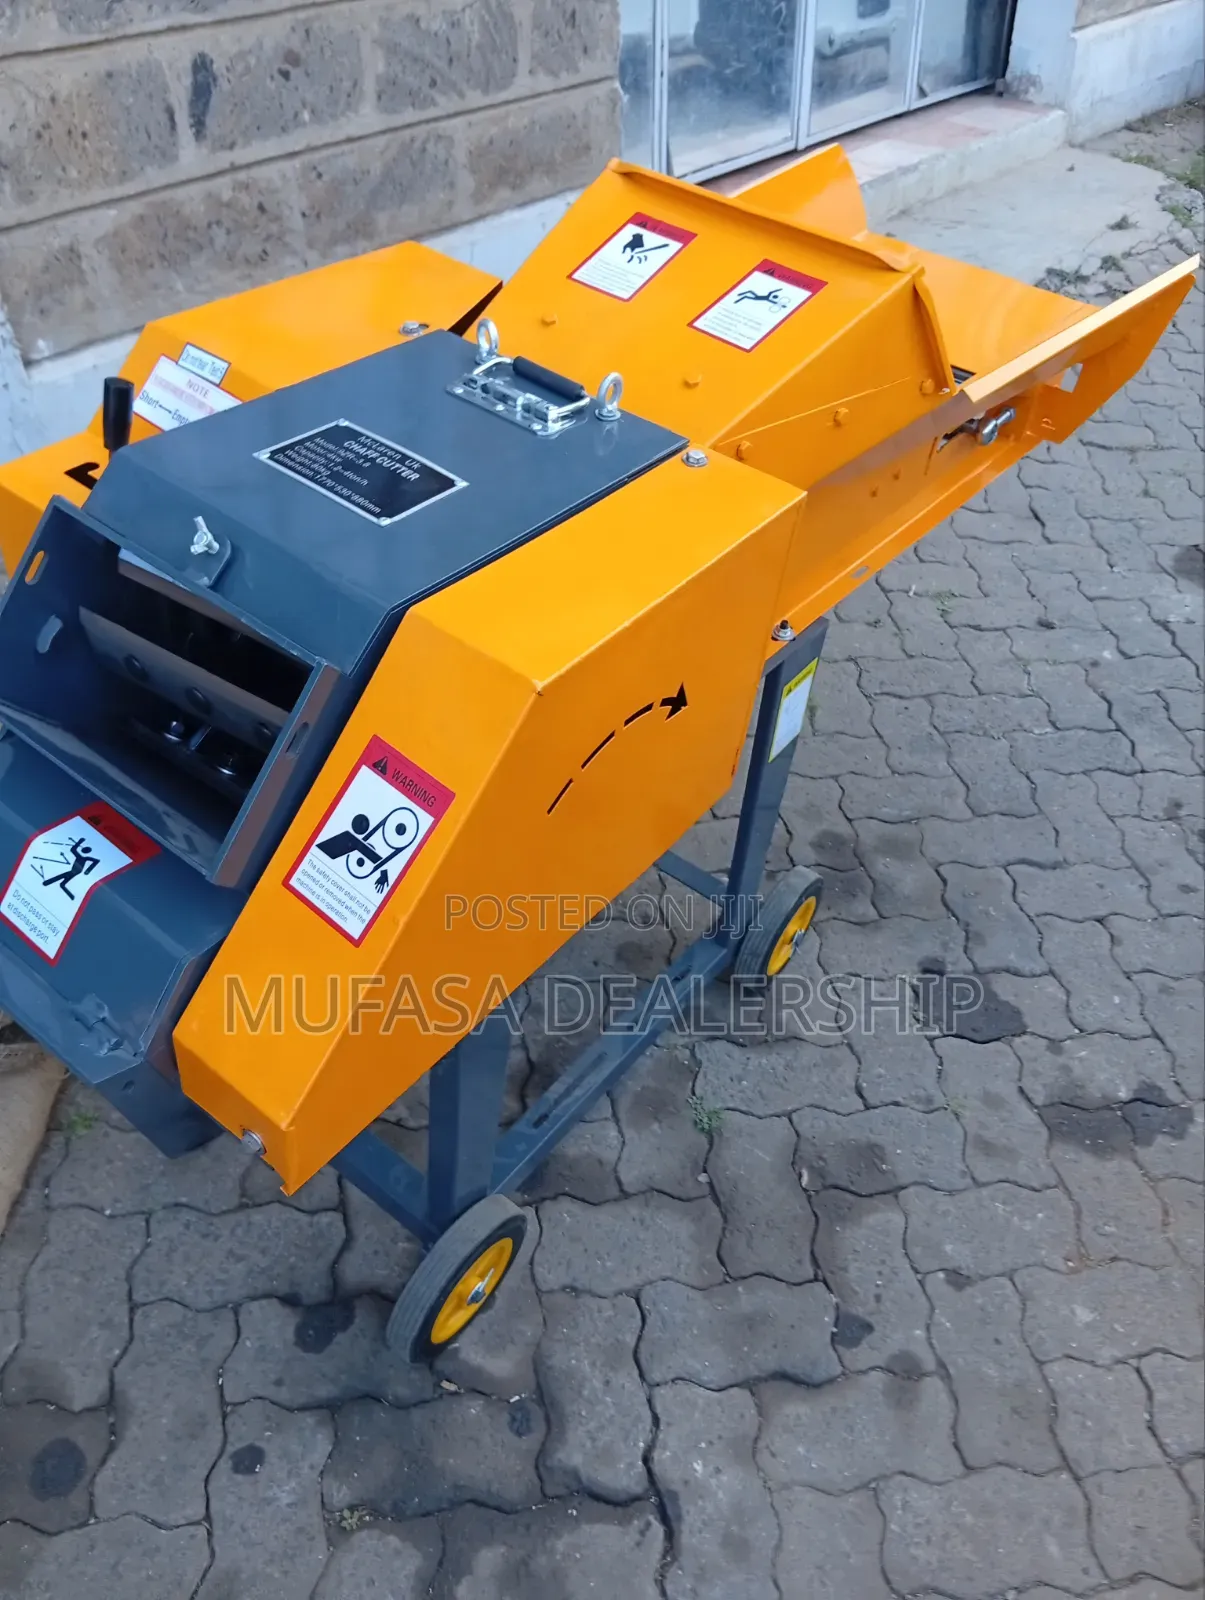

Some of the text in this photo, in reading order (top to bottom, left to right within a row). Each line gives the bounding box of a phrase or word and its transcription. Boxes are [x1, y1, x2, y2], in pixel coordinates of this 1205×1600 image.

[139, 390, 159, 409] Short
[186, 379, 210, 399] NOTE
[343, 440, 420, 482] CHAFF CUTTER
[358, 436, 402, 461] McLaren
[392, 768, 437, 808] WARNING
[295, 877, 317, 896] machine
[315, 892, 322, 900] is
[300, 868, 320, 886] opened
[324, 886, 346, 907] removed
[344, 904, 358, 916] when
[357, 913, 367, 924] the
[307, 859, 371, 914] The safety cover shall not be
[7, 902, 14, 911] at
[12, 906, 38, 933] discharge
[12, 889, 60, 937] Do not pass or stay
